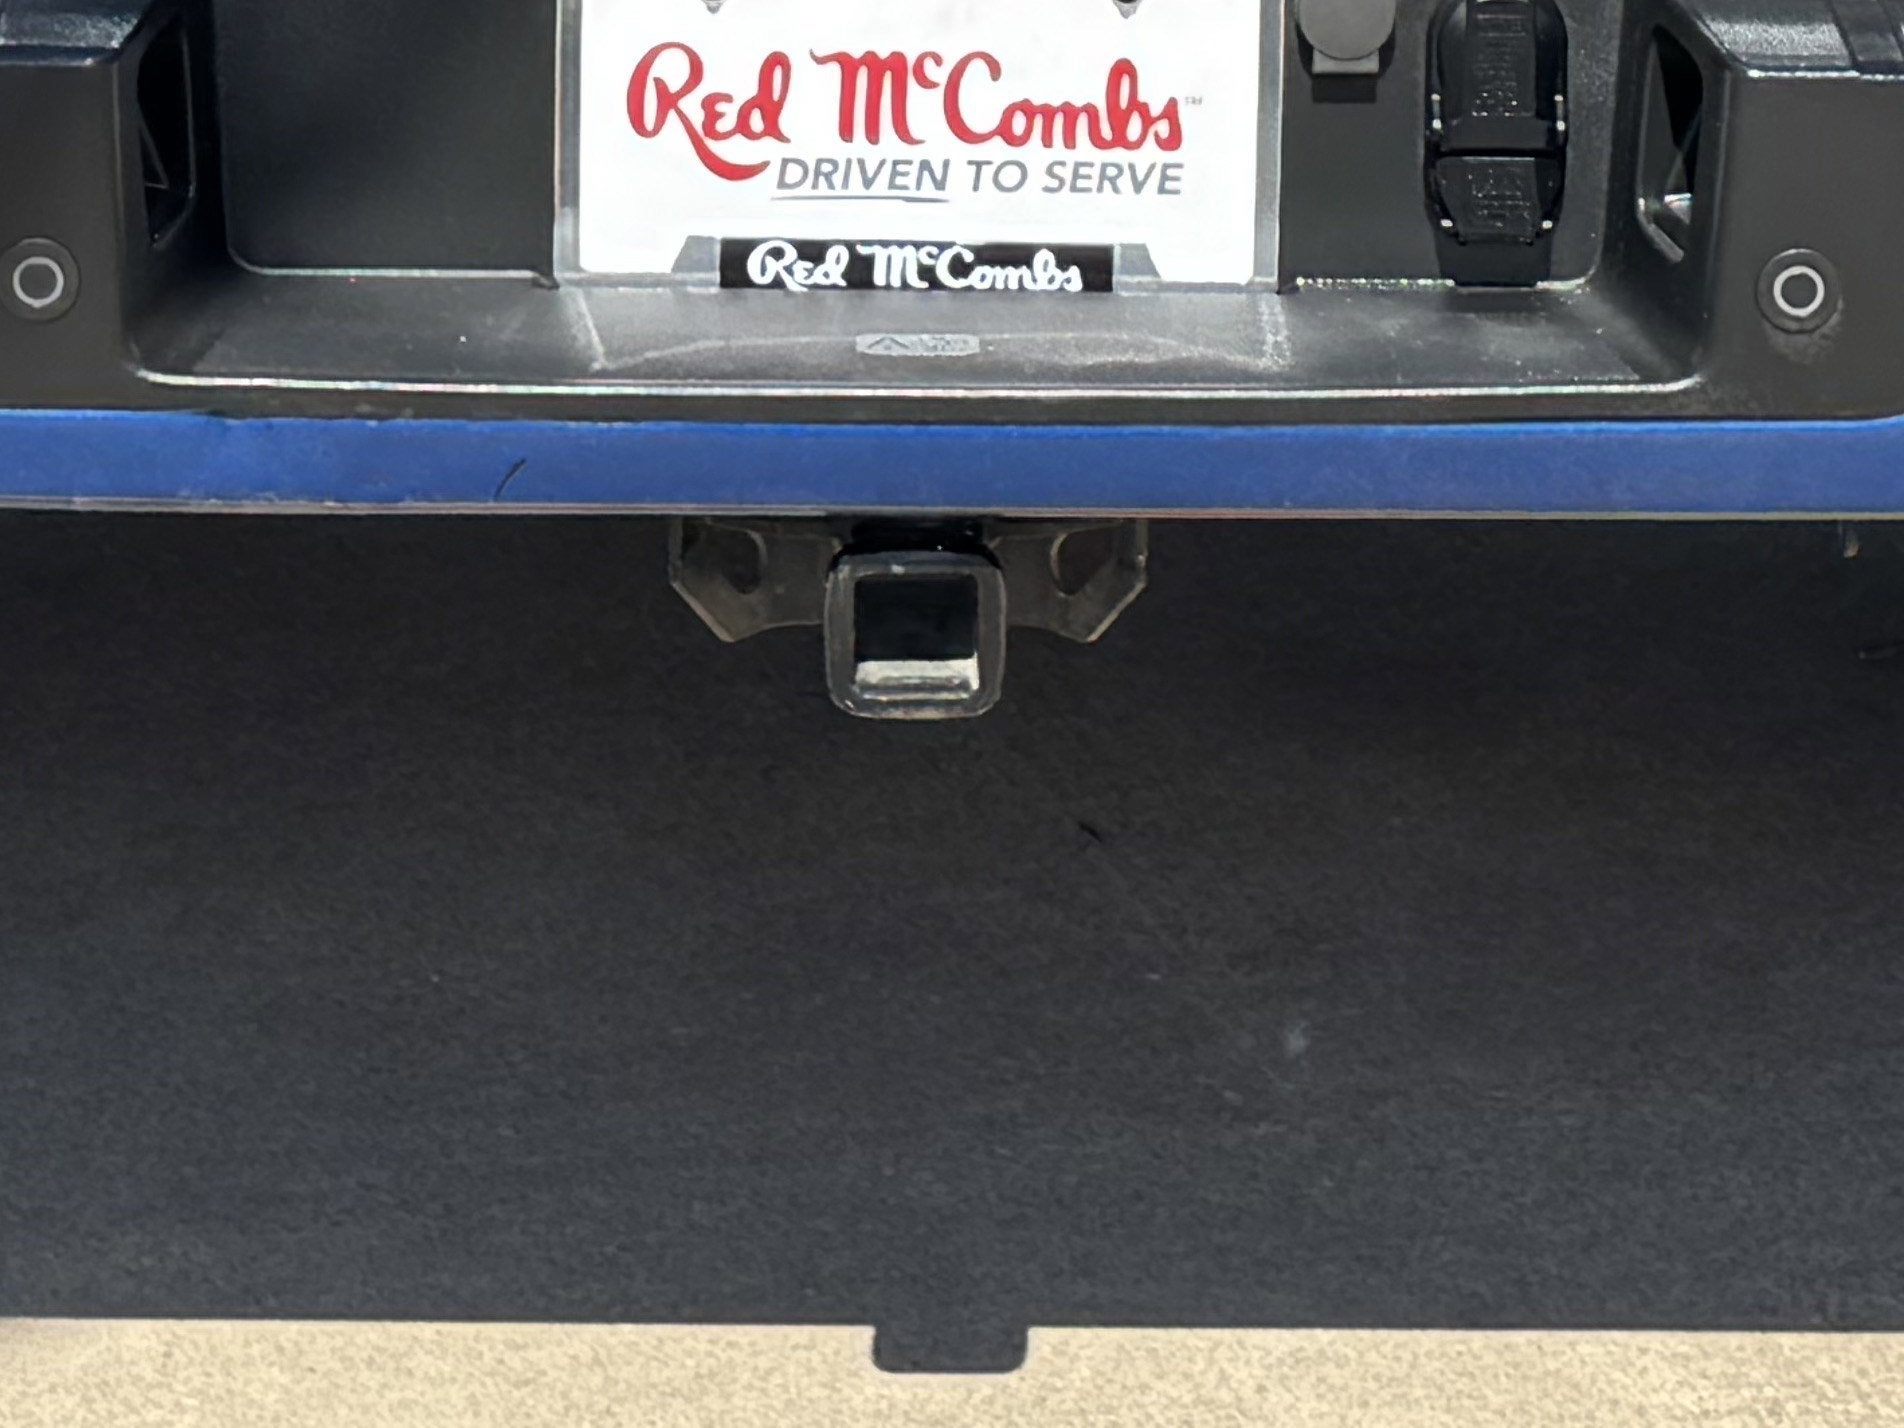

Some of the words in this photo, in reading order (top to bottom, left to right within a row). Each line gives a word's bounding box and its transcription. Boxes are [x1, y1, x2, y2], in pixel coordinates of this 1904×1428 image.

[626, 41, 792, 181] Red
[809, 48, 1183, 151] McCombs
[776, 157, 950, 191] DRIVEN
[967, 159, 1028, 193] TO
[1041, 160, 1184, 195] SERVE
[746, 239, 849, 292] Red
[856, 243, 1084, 292] McCombs
